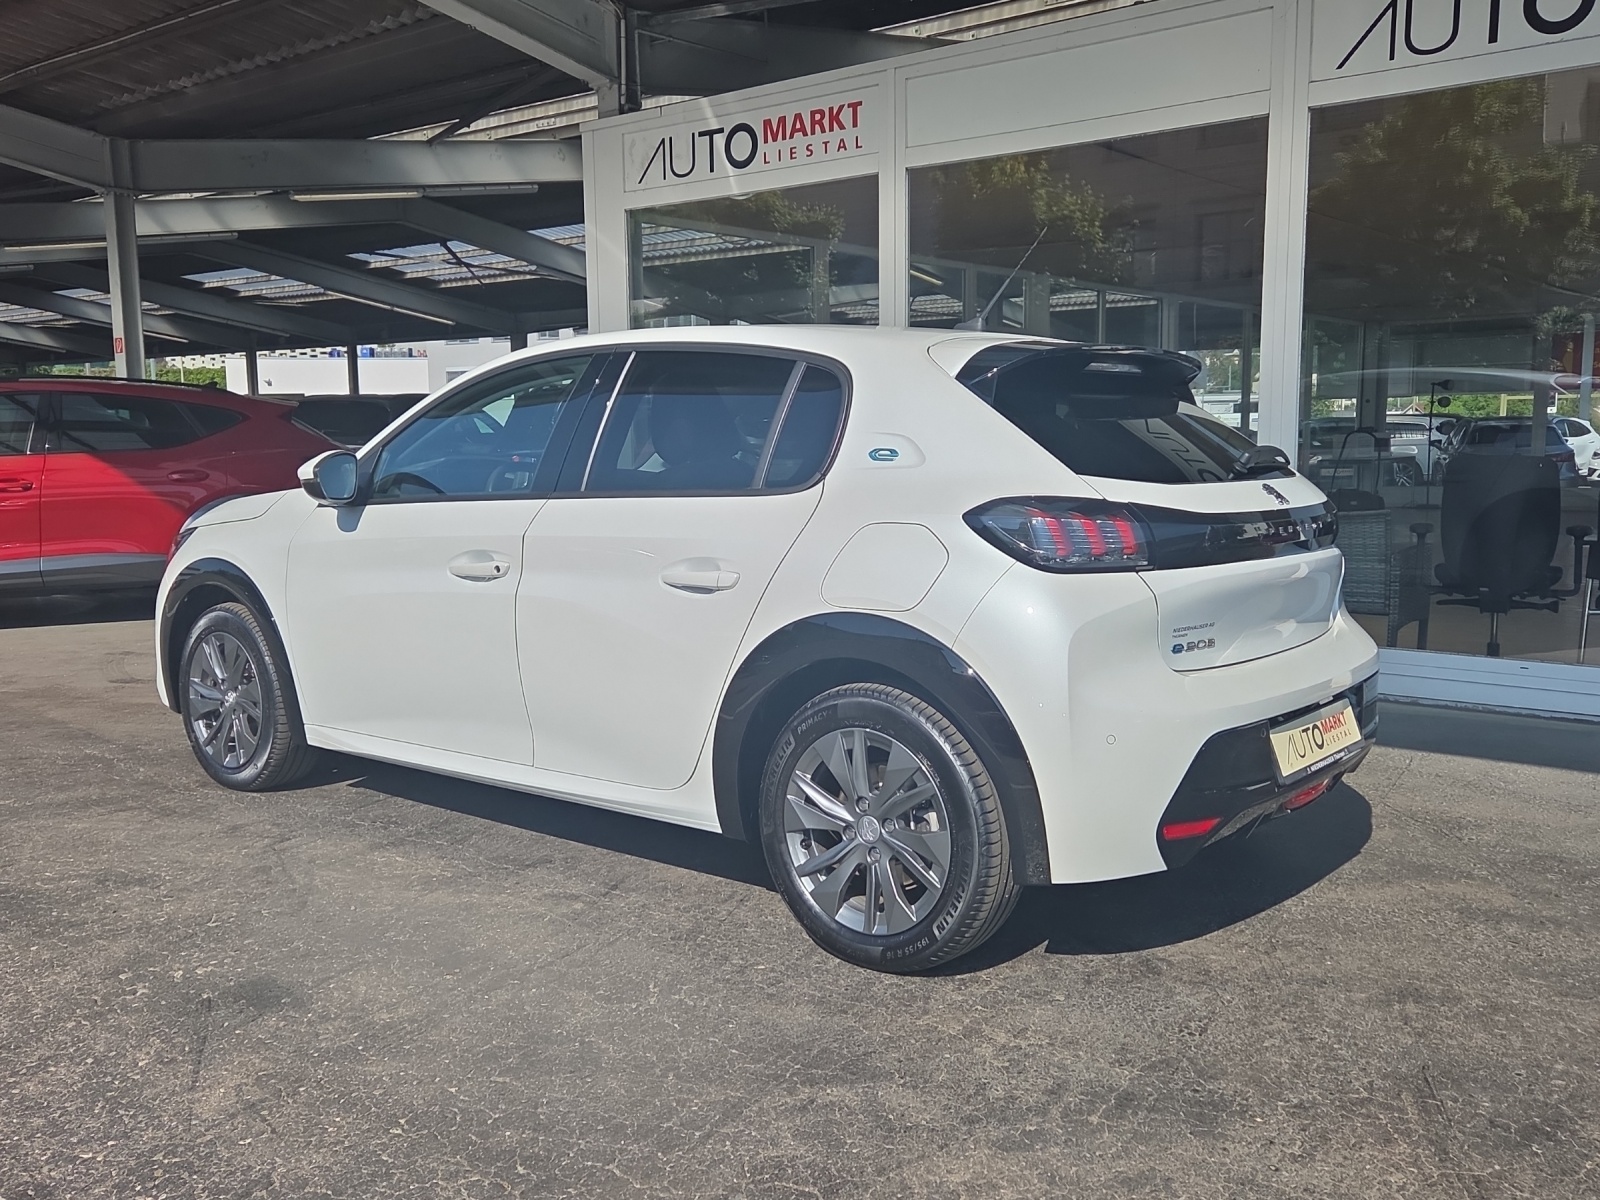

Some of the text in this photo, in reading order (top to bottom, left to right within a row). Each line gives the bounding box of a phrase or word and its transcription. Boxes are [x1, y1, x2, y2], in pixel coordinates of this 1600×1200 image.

[638, 100, 863, 185] AUTO MARKT
[763, 135, 863, 165] LIESTAL
[797, 710, 828, 735] PRIMACY
[1287, 723, 1325, 765] AUTO
[1320, 710, 1348, 735] MARKT
[1325, 728, 1352, 746] LIESTAL
[904, 936, 930, 956] 195/55
